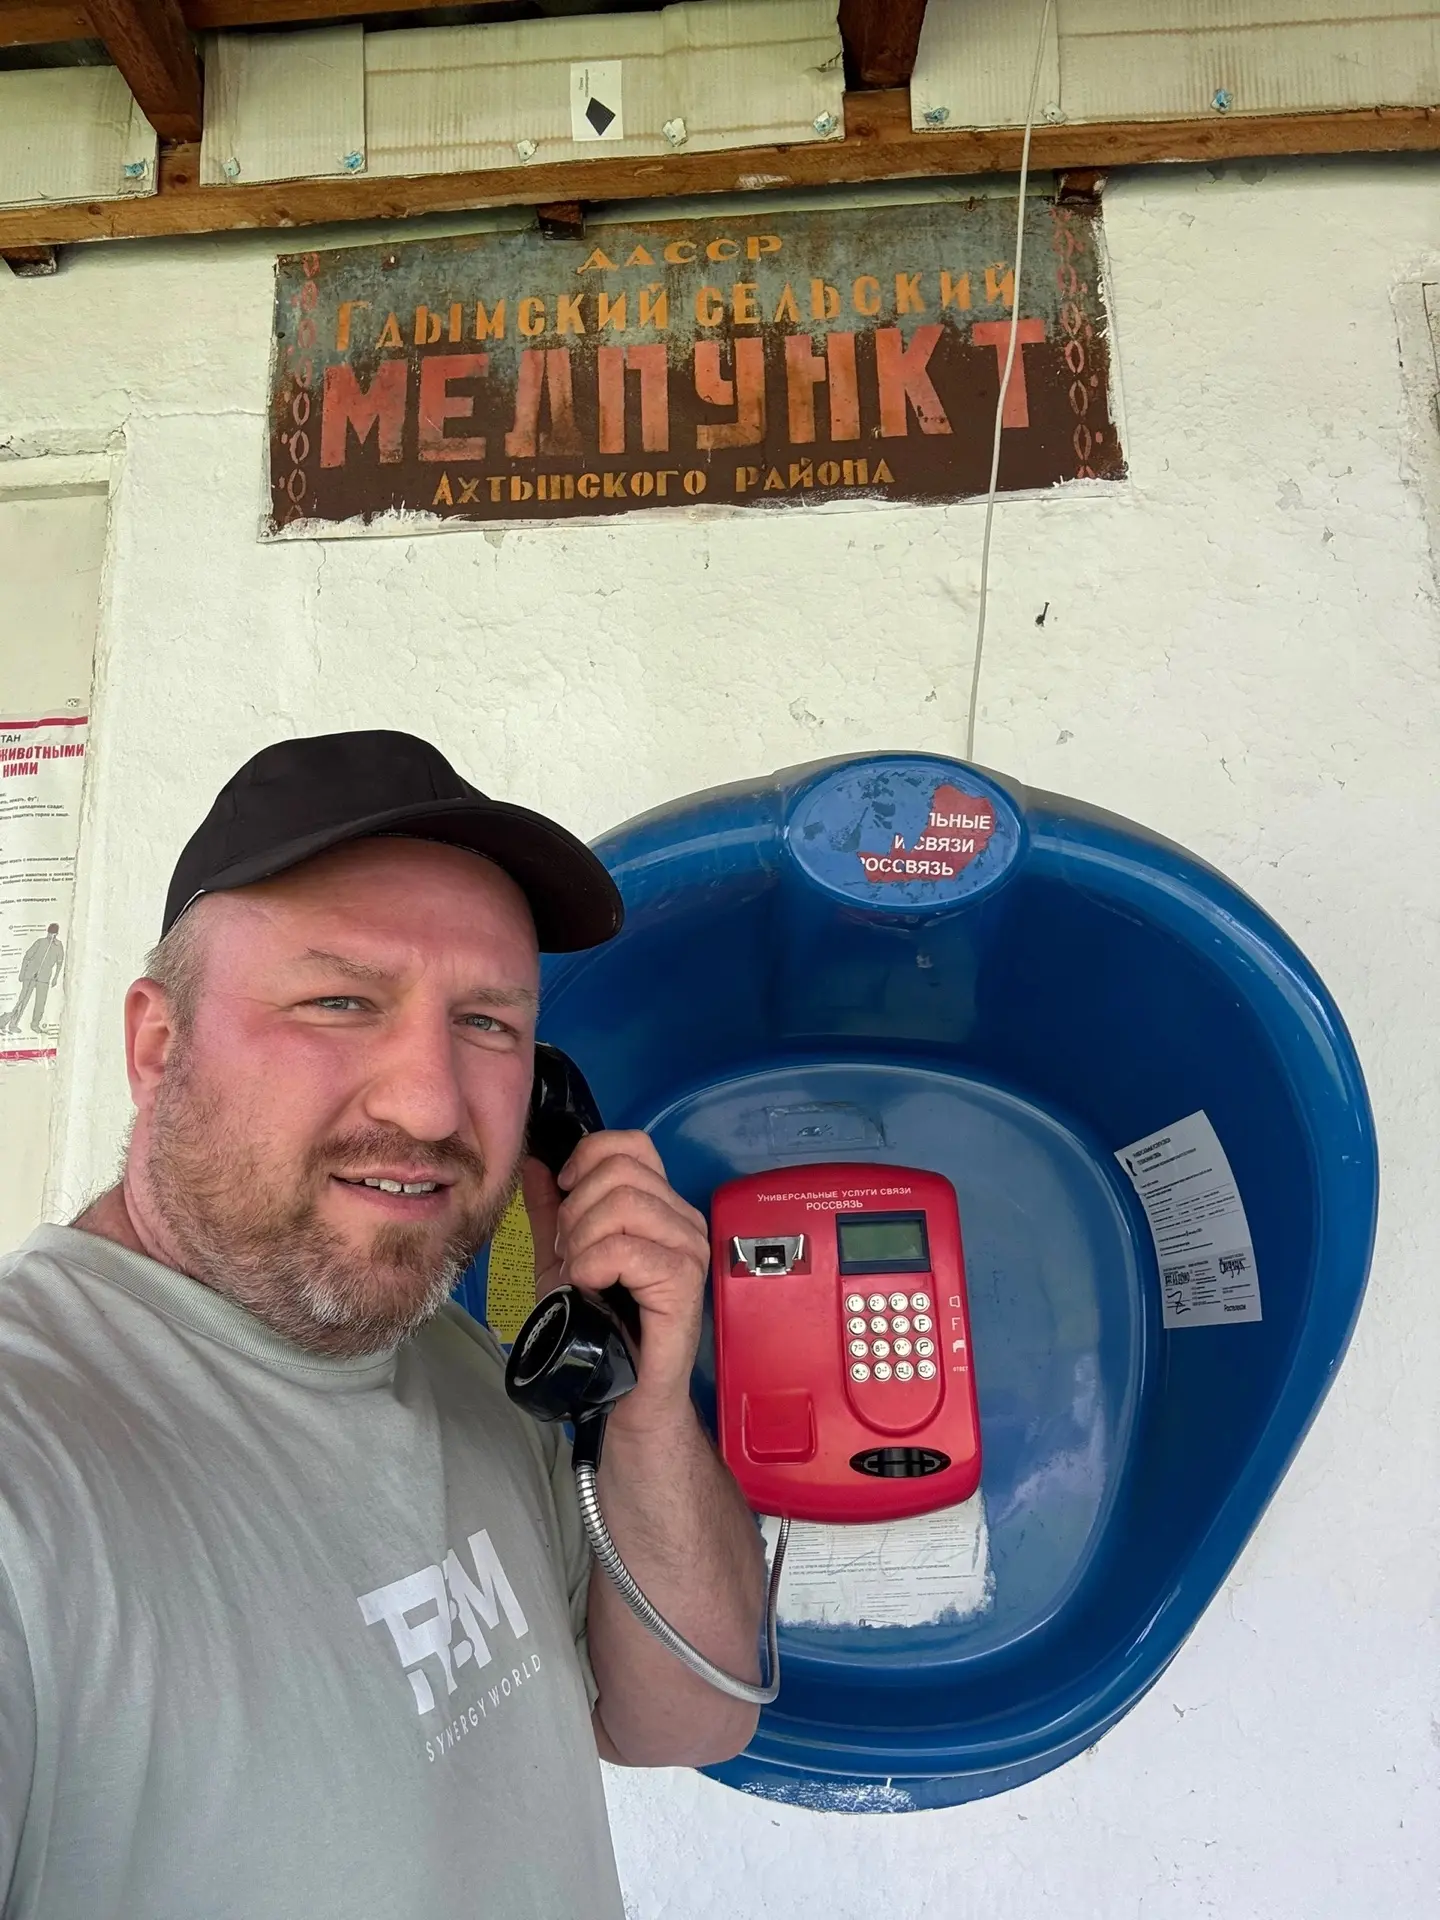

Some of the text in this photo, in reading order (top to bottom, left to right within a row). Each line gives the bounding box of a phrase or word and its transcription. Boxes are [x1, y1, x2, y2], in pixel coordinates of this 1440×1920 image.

[320, 318, 1046, 469] МЕДПУНКТ
[860, 857, 954, 876] ОССВЯЗЬ
[757, 1187, 912, 1202] УНИВЕРСАЛЬНЫЕ УСЛУГИ СВЯЗИ
[806, 1200, 863, 1211] РОССВЯЗЬ
[918, 1318, 926, 1329] F
